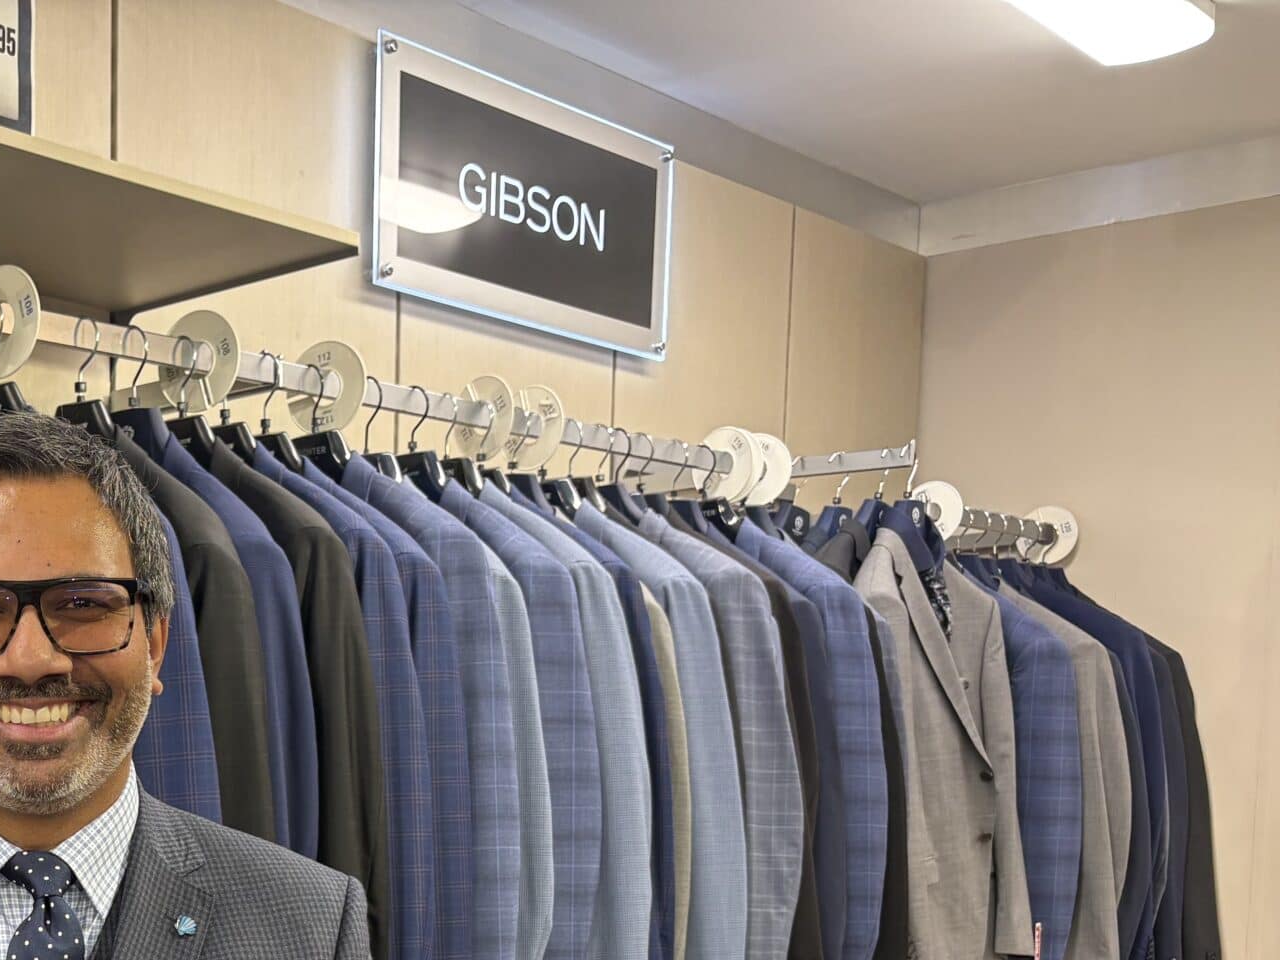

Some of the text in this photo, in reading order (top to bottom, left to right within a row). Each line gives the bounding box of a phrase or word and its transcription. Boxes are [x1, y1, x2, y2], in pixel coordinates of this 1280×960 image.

[458, 163, 605, 251] GIBSON
[22, 295, 34, 315] 108
[220, 338, 231, 356] 108
[317, 352, 331, 363] 112
